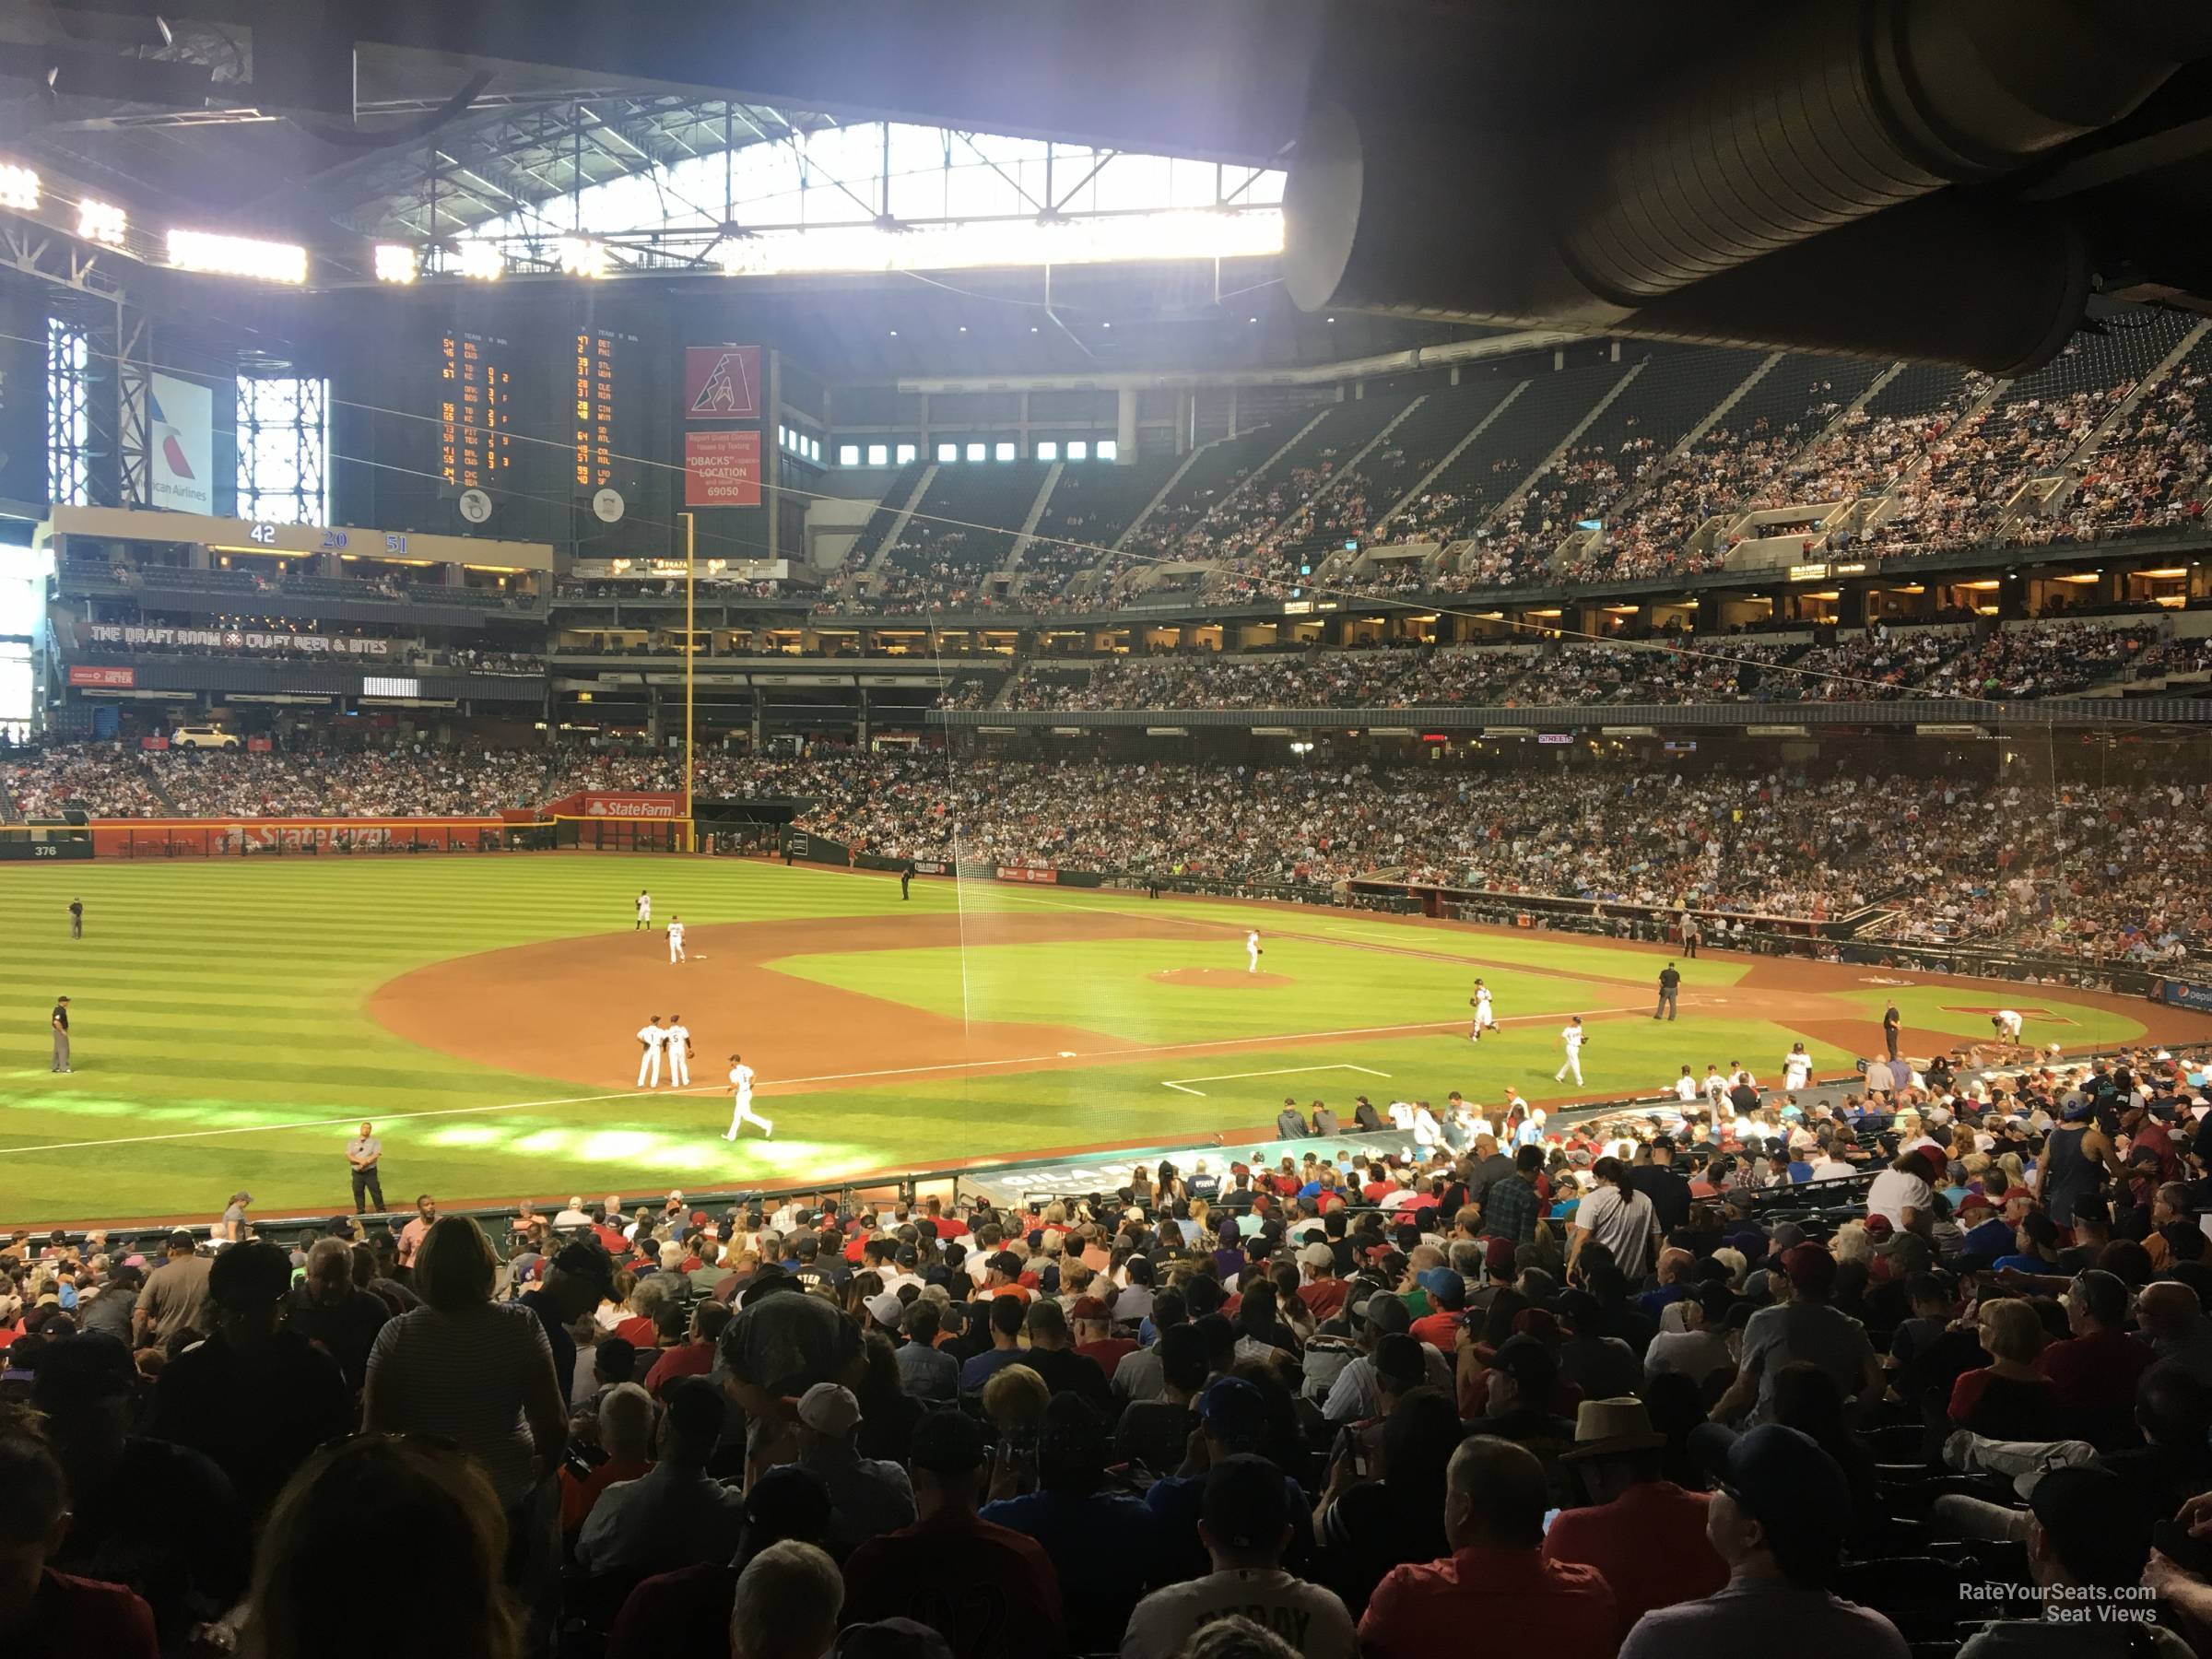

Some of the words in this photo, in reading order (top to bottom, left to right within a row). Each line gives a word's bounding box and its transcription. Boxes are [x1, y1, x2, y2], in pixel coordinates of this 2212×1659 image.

[700, 467, 747, 477] LOCATION
[172, 485, 206, 501] Airlines
[708, 487, 738, 496] 69050
[251, 524, 276, 544] 42
[323, 531, 347, 548] 20
[385, 535, 408, 554] 51
[91, 626, 121, 641] THE
[124, 628, 173, 643] DRAFT
[177, 630, 221, 646] ROOM
[245, 633, 290, 649] CRAFT
[293, 636, 329, 652] BEER
[333, 639, 347, 652] &
[349, 639, 387, 654] BITES
[35, 846, 56, 855] 376
[1001, 1168, 1102, 1187] GILA
